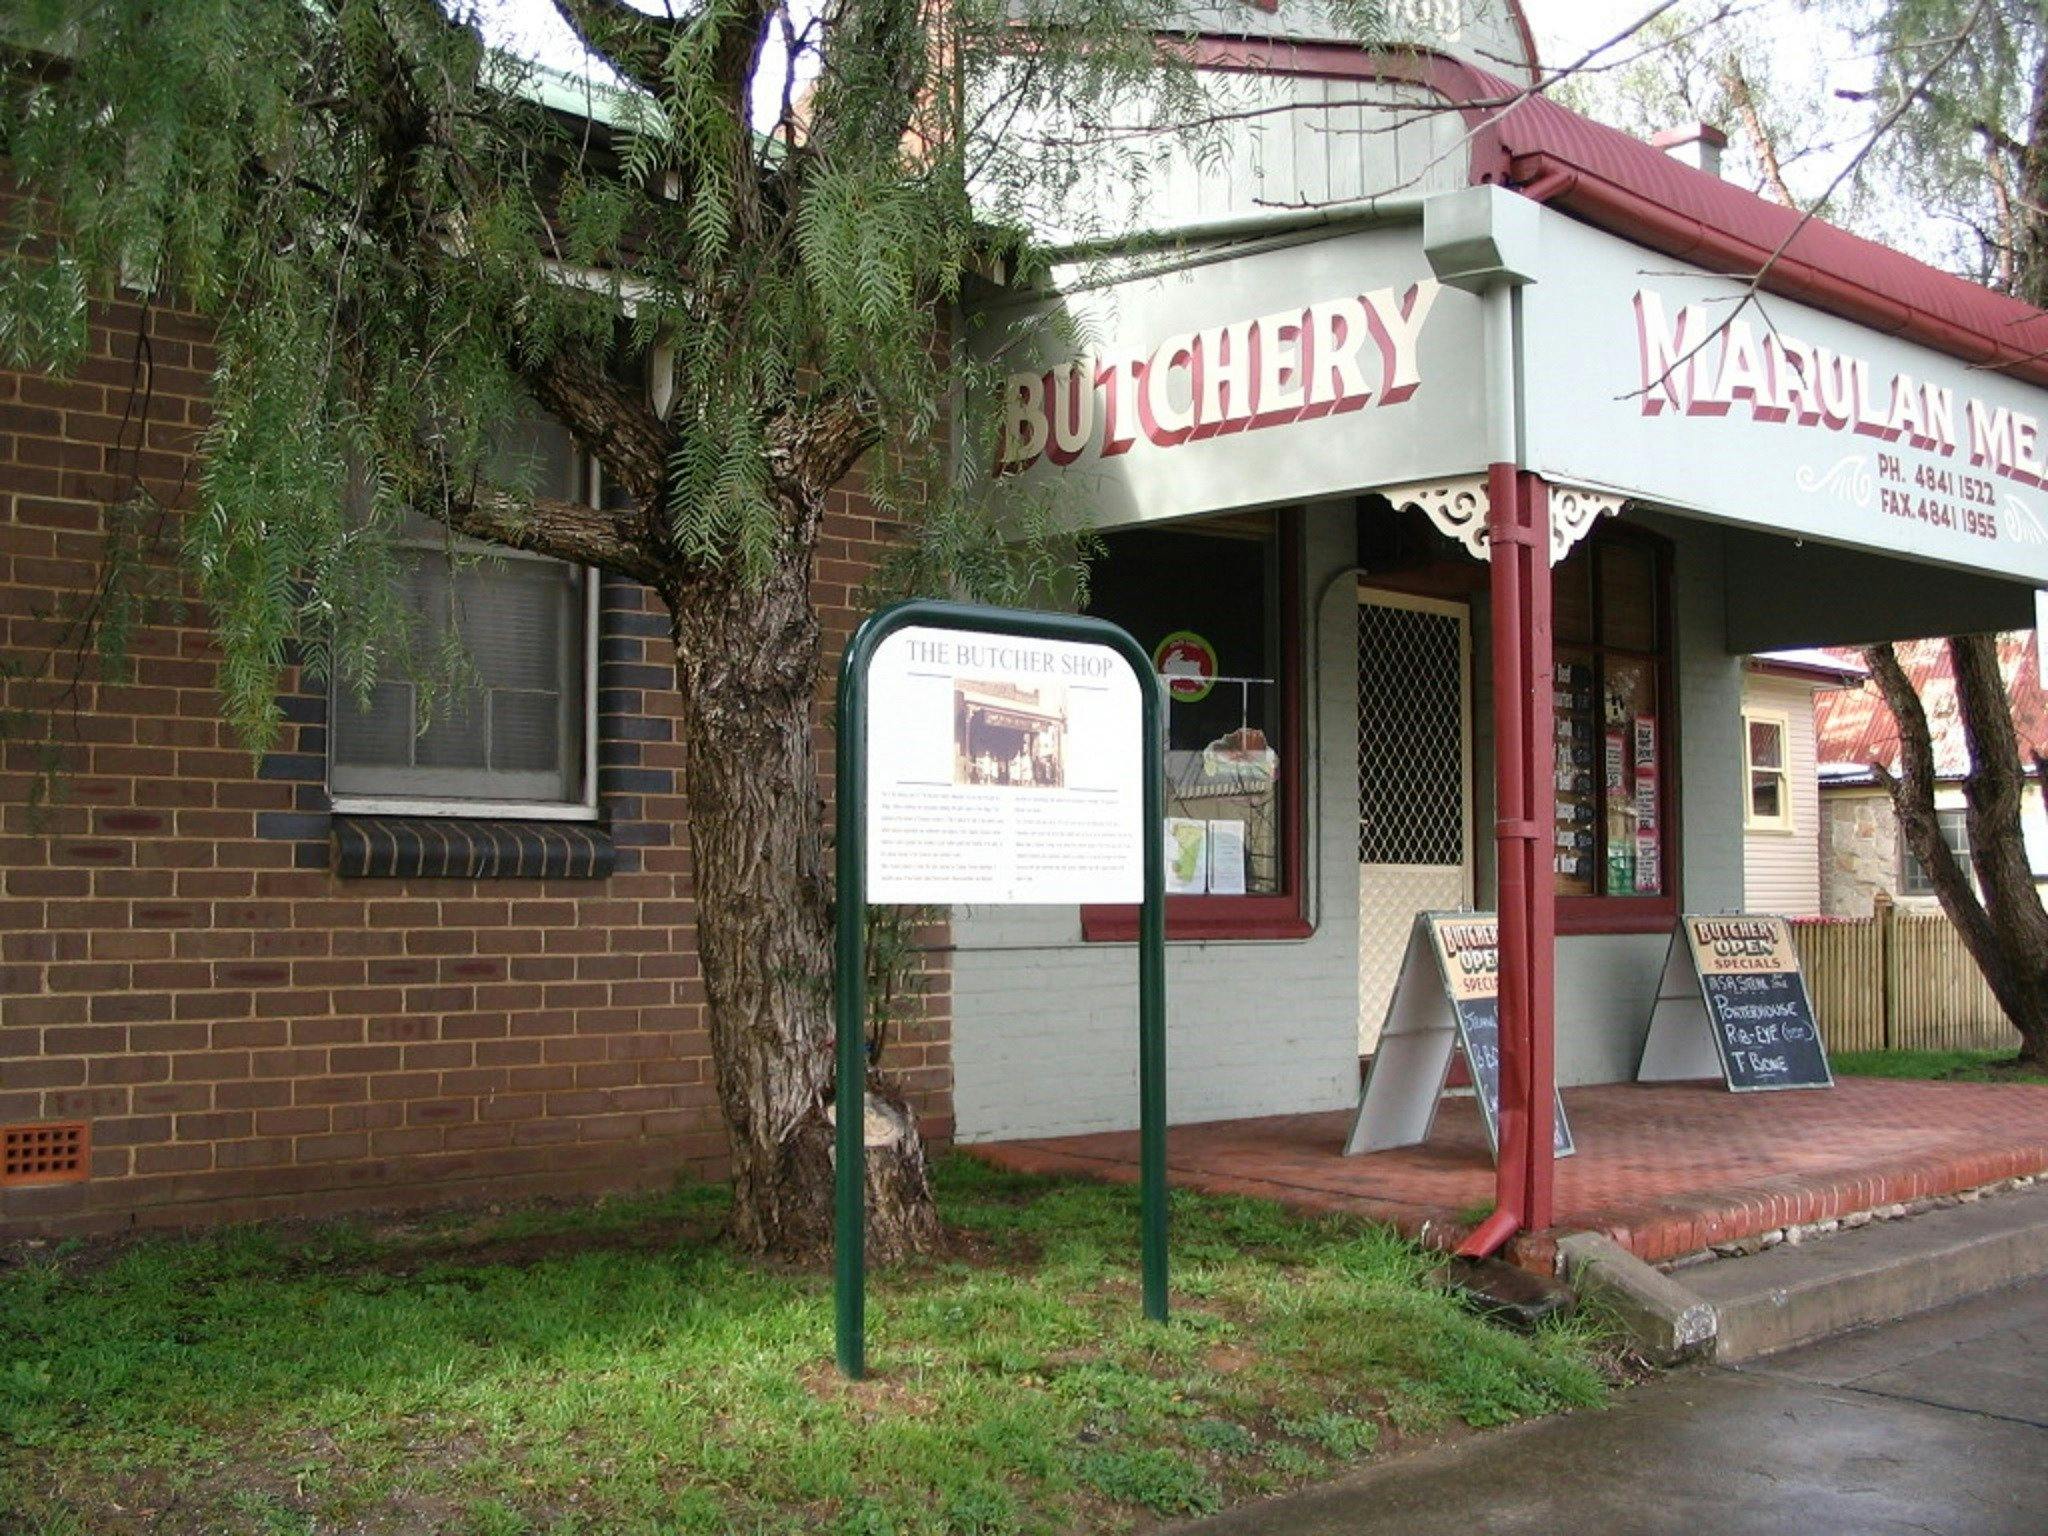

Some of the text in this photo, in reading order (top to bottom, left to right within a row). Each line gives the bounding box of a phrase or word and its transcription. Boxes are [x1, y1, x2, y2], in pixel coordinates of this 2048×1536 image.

[993, 277, 1440, 478] BUTCHERY
[1633, 288, 2047, 492] MARULAN ME
[1877, 453, 1995, 506] PH. 4841 1522
[1962, 508, 1997, 539] 1955
[906, 639, 1113, 678] THE BUTCHER SHOP
[1695, 921, 1778, 944] BUTCHERY
[1461, 949, 1498, 974] OPE
[1715, 939, 1774, 956] OPEN
[1714, 957, 1781, 969] SPECIALS
[1463, 976, 1498, 993] SPECI
